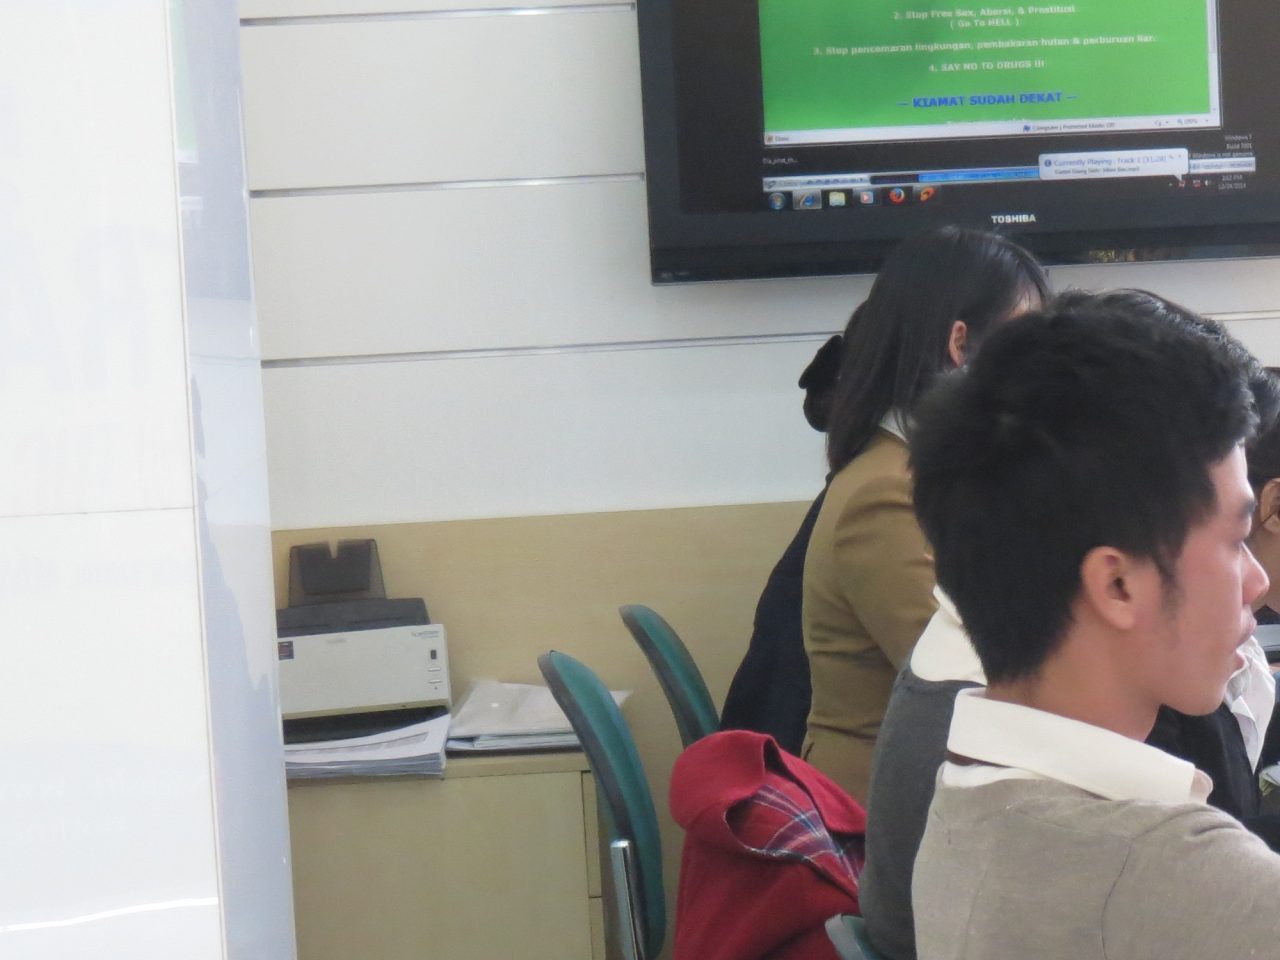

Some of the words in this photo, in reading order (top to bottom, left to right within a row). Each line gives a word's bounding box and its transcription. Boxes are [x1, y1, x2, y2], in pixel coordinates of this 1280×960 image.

[905, 11, 928, 20] Stop
[931, 10, 953, 18] Free
[973, 19, 986, 27] To
[988, 18, 1012, 27] HELL
[825, 46, 849, 56] Stop
[941, 63, 961, 72] SAY
[963, 62, 979, 71] NO
[982, 61, 994, 70] TO
[996, 60, 1032, 70] DRUGS
[912, 96, 964, 109] KIAMAT
[969, 94, 1015, 107] SUDAH
[1019, 91, 1063, 104] DEKAT
[991, 213, 1037, 224] TOSHIBA
